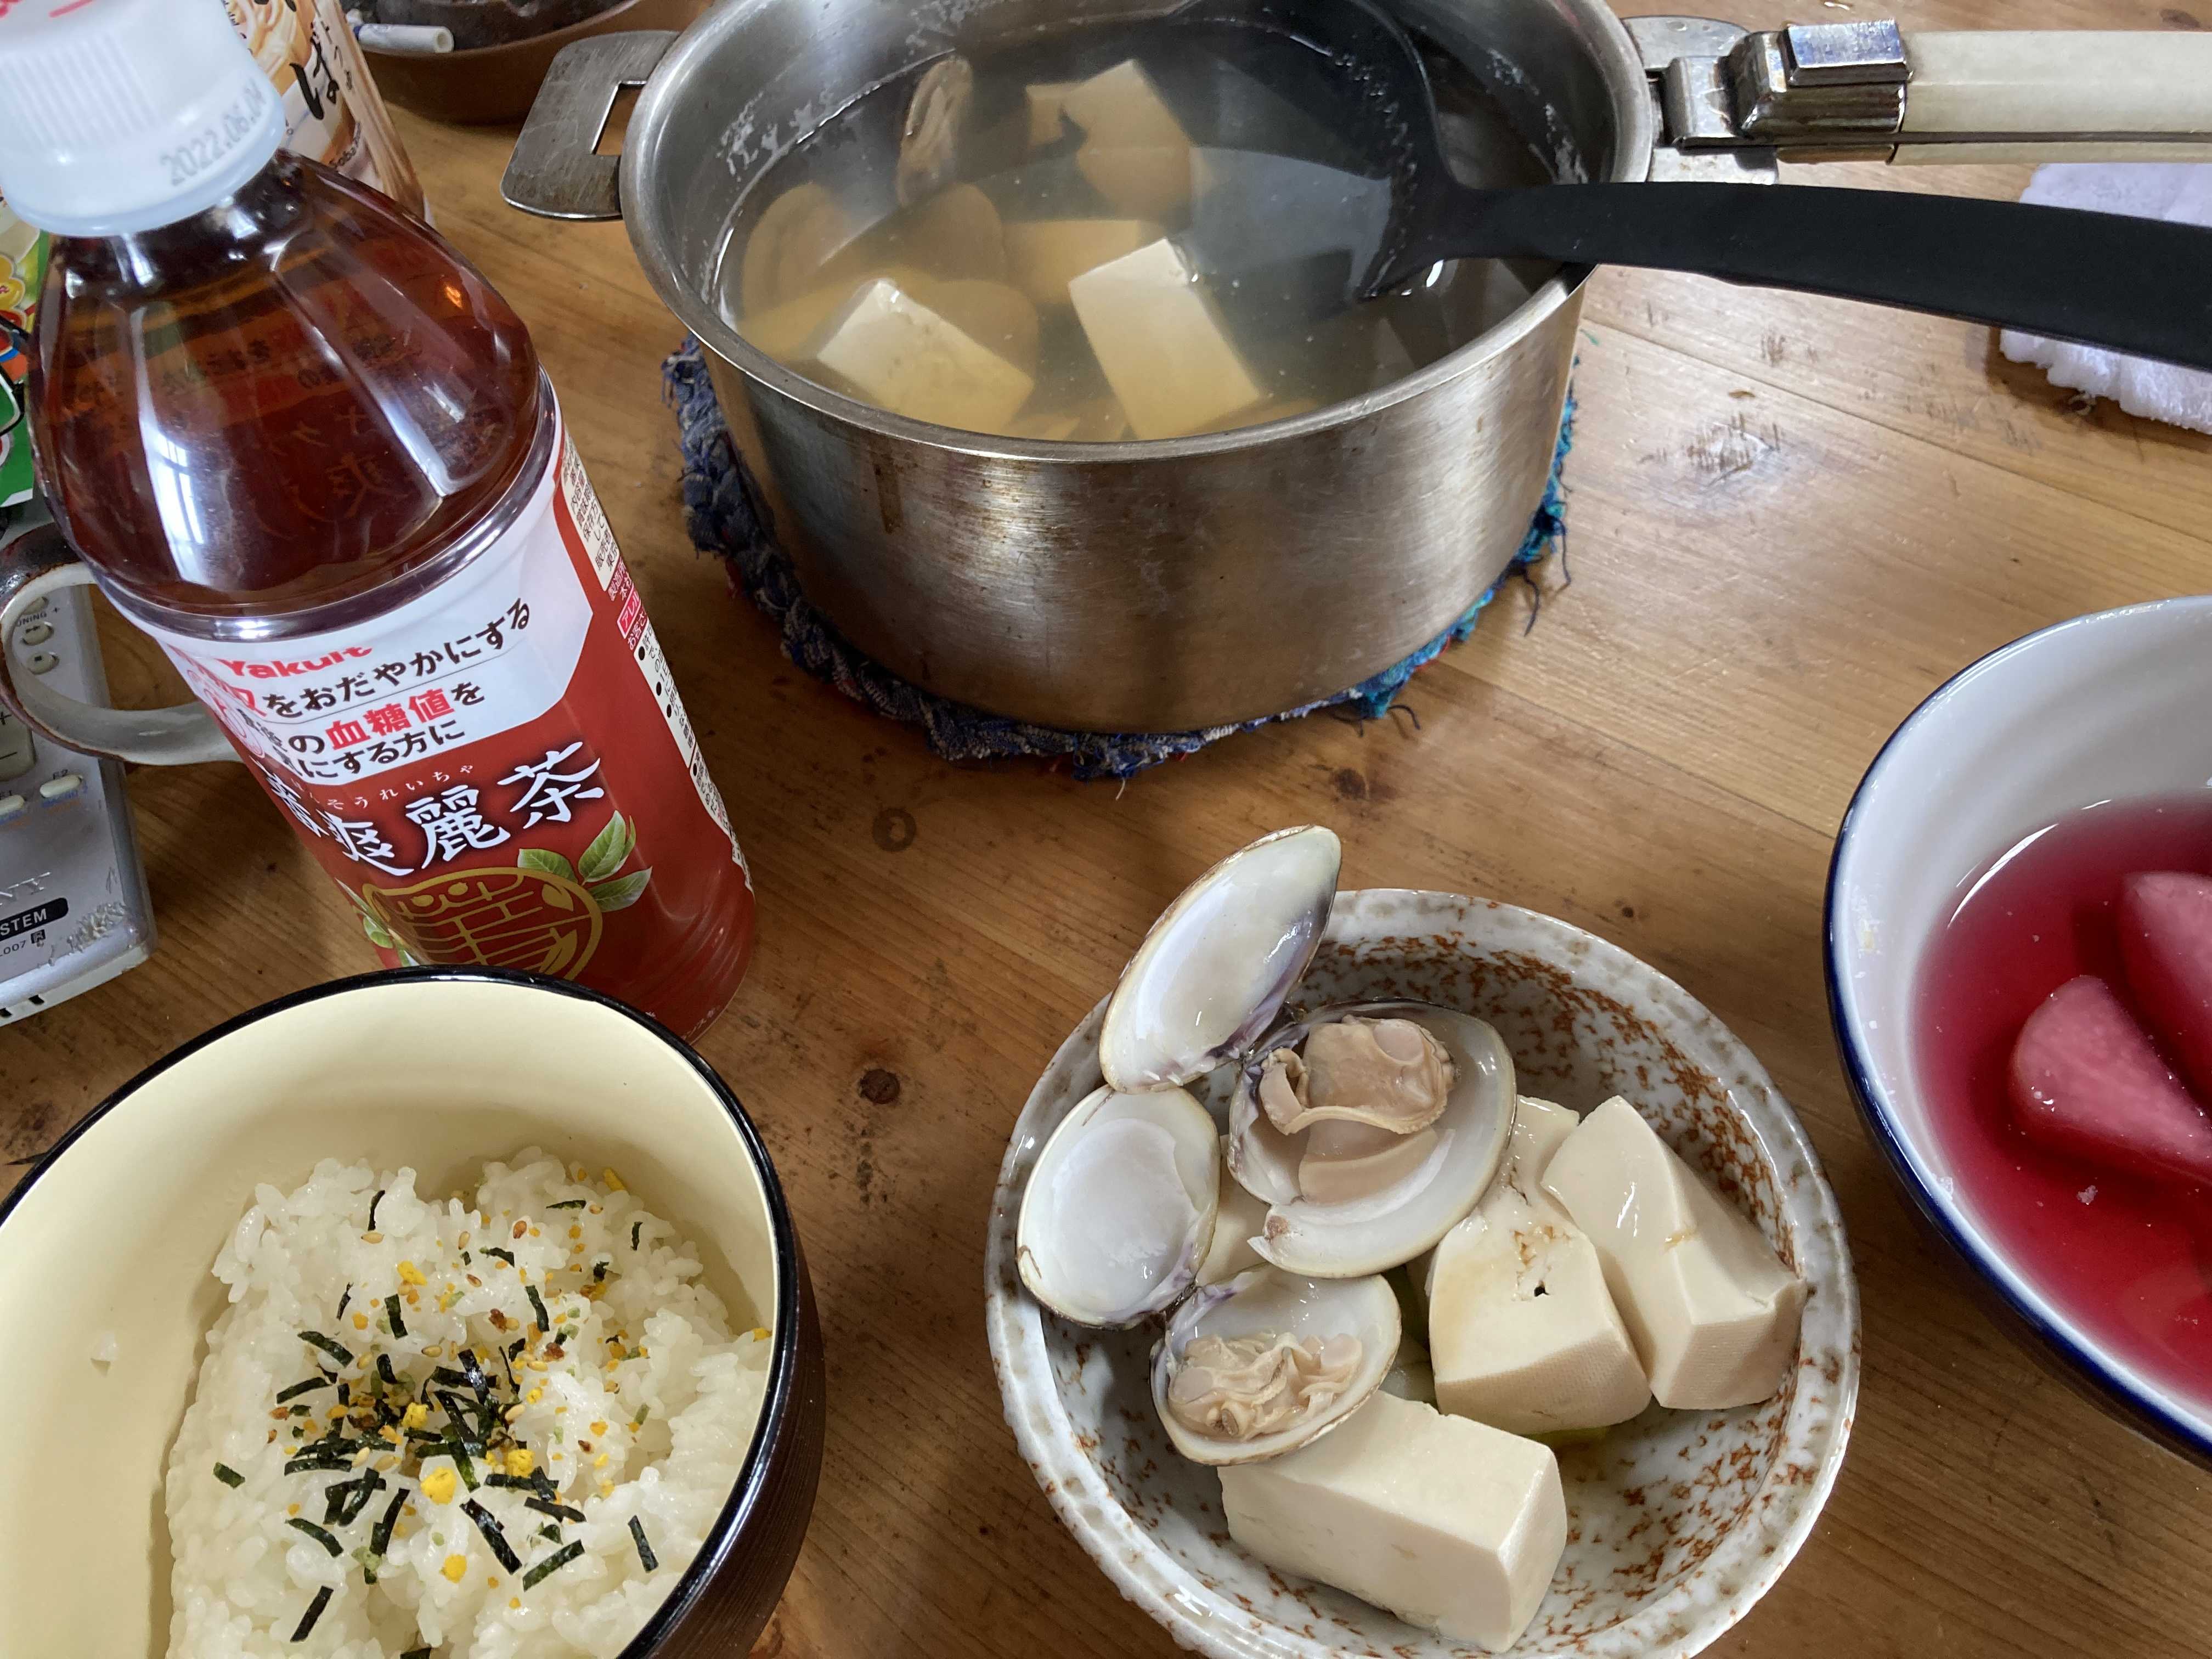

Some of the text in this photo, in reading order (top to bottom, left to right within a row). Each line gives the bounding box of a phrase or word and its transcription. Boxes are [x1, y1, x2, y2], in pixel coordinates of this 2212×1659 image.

[215, 644, 373, 679] Yakult
[0, 907, 47, 936] STEM
[0, 939, 26, 957] 007
